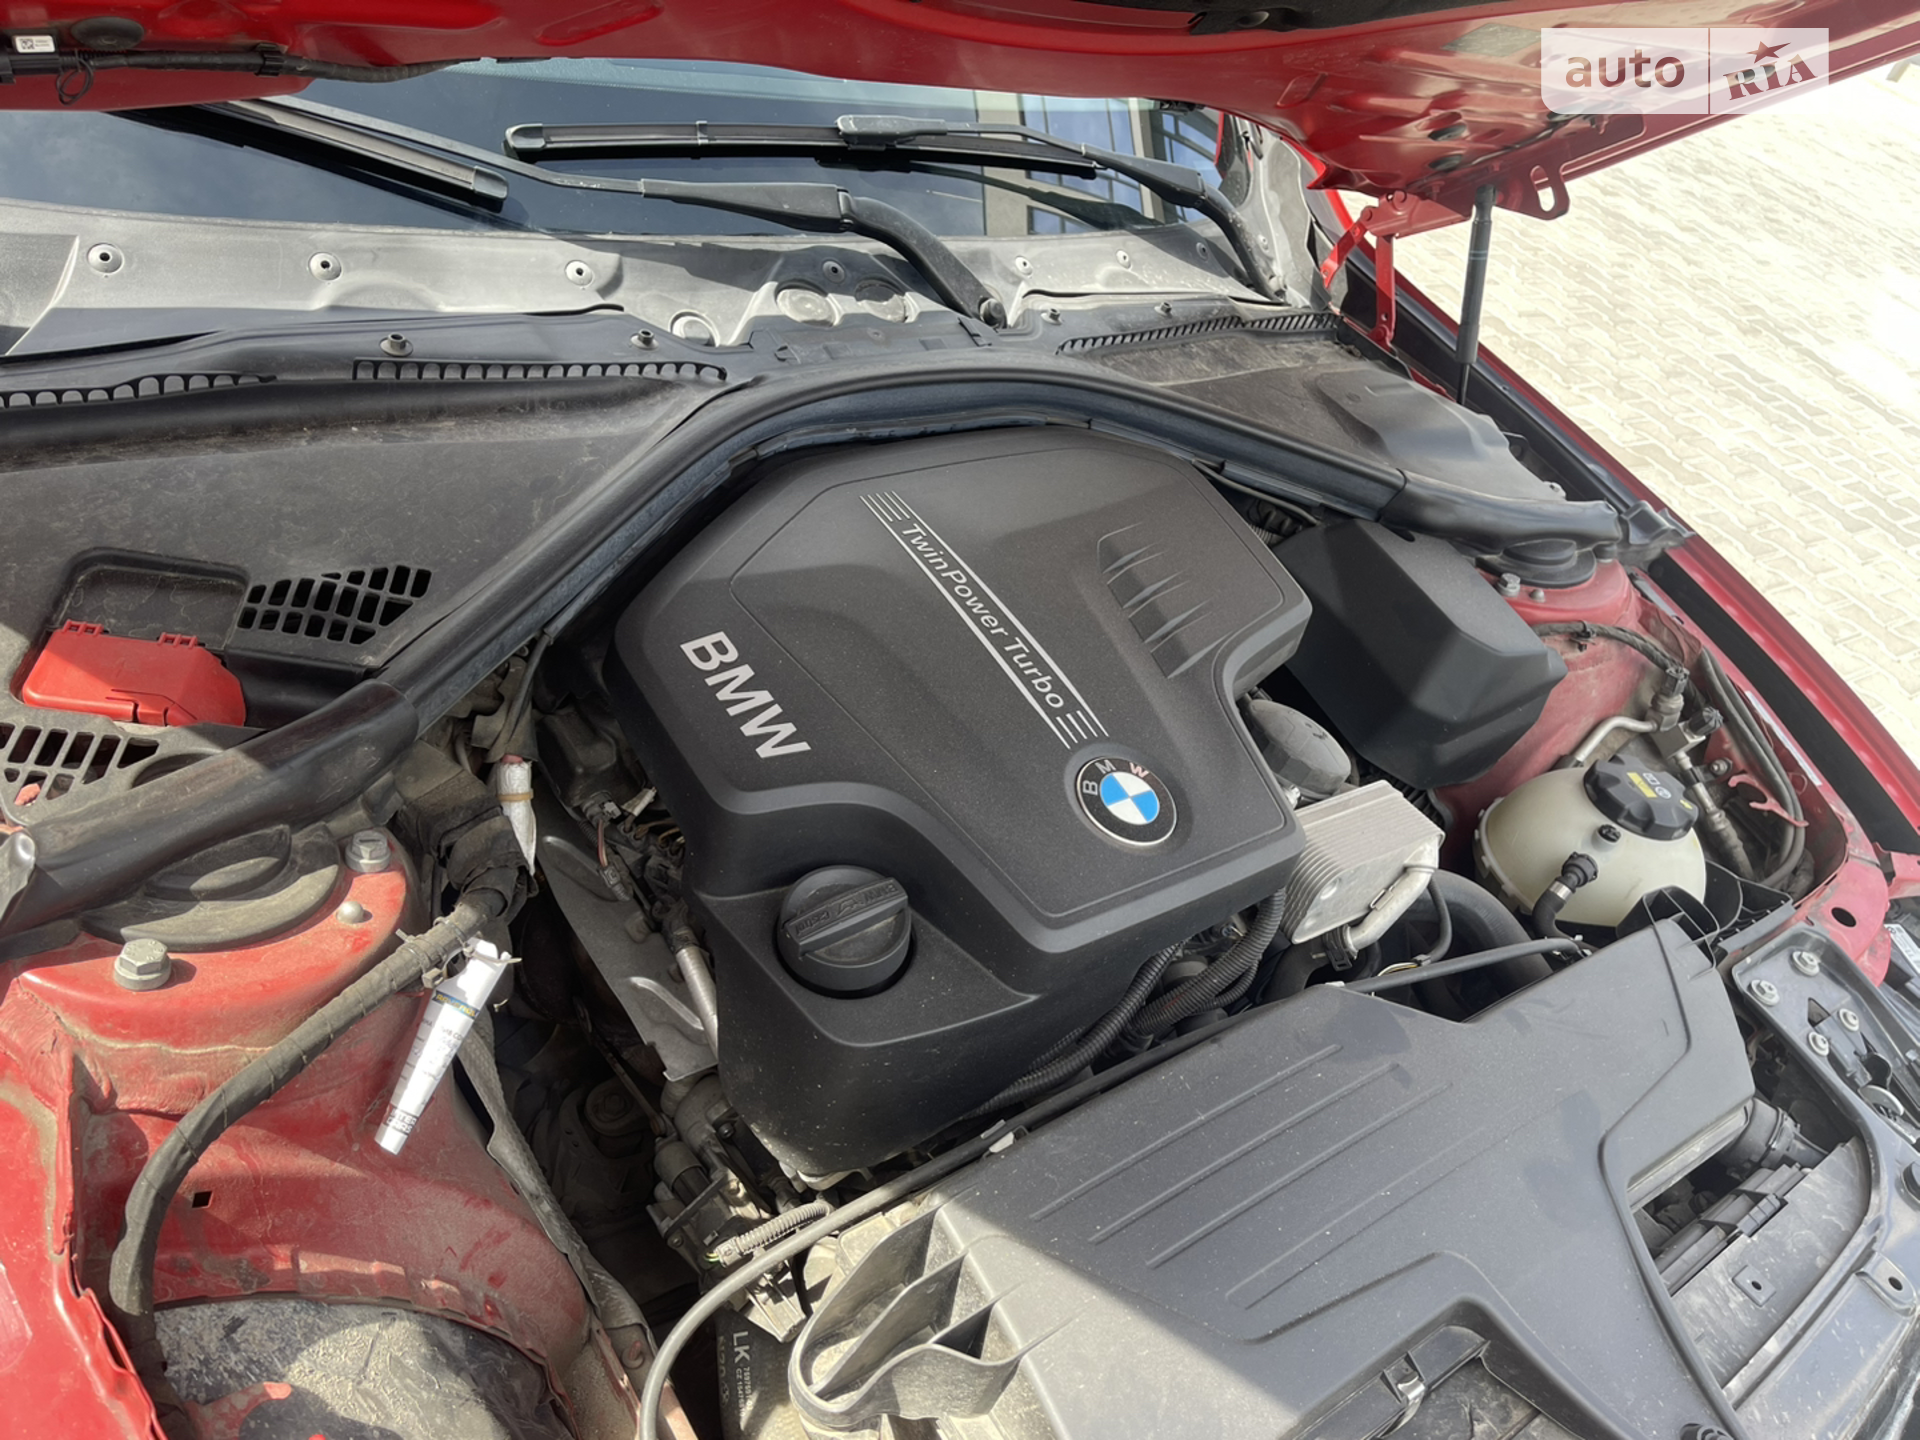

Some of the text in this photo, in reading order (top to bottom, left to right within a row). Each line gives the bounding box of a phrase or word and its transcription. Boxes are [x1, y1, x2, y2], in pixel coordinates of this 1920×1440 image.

[902, 523, 1065, 709] TwinPower Turbo
[680, 631, 812, 759] BMW
[1082, 759, 1150, 796] BMW
[733, 1331, 750, 1363] LK
